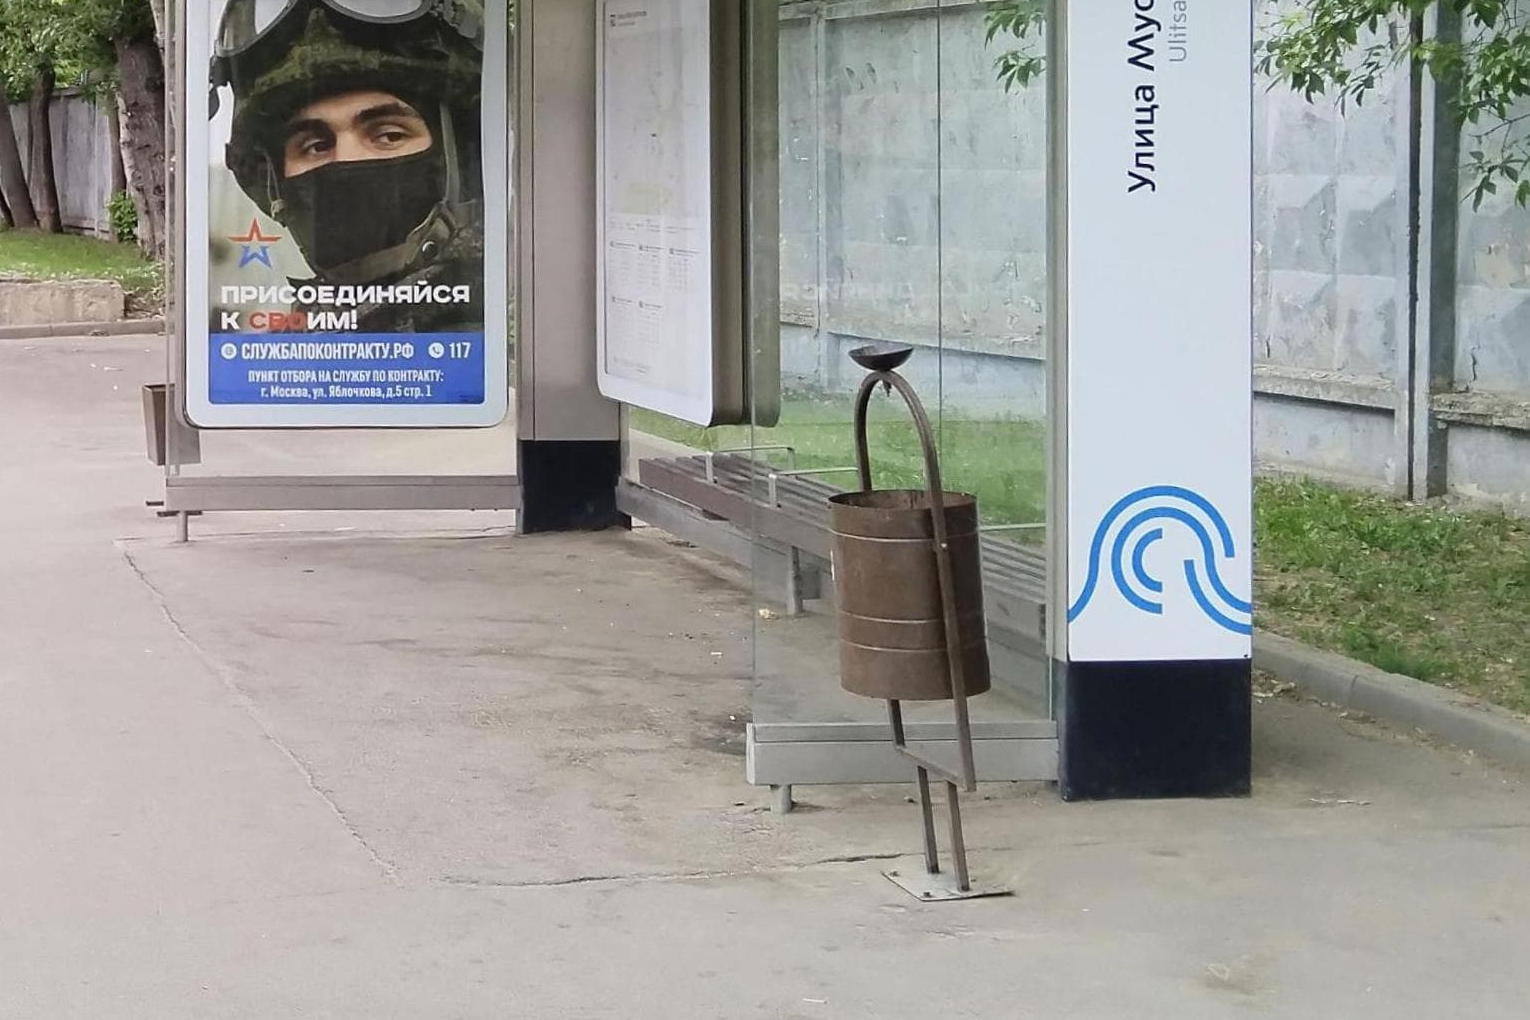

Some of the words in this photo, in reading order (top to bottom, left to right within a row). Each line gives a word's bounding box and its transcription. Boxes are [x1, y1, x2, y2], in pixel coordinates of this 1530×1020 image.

[1167, 0, 1188, 63] Ulitsa
[1127, 83, 1160, 194] Улица
[220, 281, 471, 307] ПРИСОЕДИНЯЙСЯ
[221, 312, 240, 330] К
[248, 310, 359, 331] СВОИМ!
[241, 342, 414, 360] СЛУЖБАПОКОНТРАКТУ.РФ
[449, 342, 471, 359] 117
[248, 370, 280, 383] ПУНКТ
[281, 370, 318, 383] ОТБОРА
[319, 370, 332, 383] НА
[333, 370, 371, 383] СЛУЖБУ
[373, 370, 386, 383] ПО
[387, 370, 445, 383] КОНТРАКТУ:
[260, 388, 269, 398] г.
[270, 386, 312, 399] Москва,
[312, 387, 328, 400] ул.
[328, 384, 385, 399] Яблочкова,
[386, 385, 402, 399] д.5
[403, 387, 425, 400] стр.
[426, 384, 432, 397] 1
